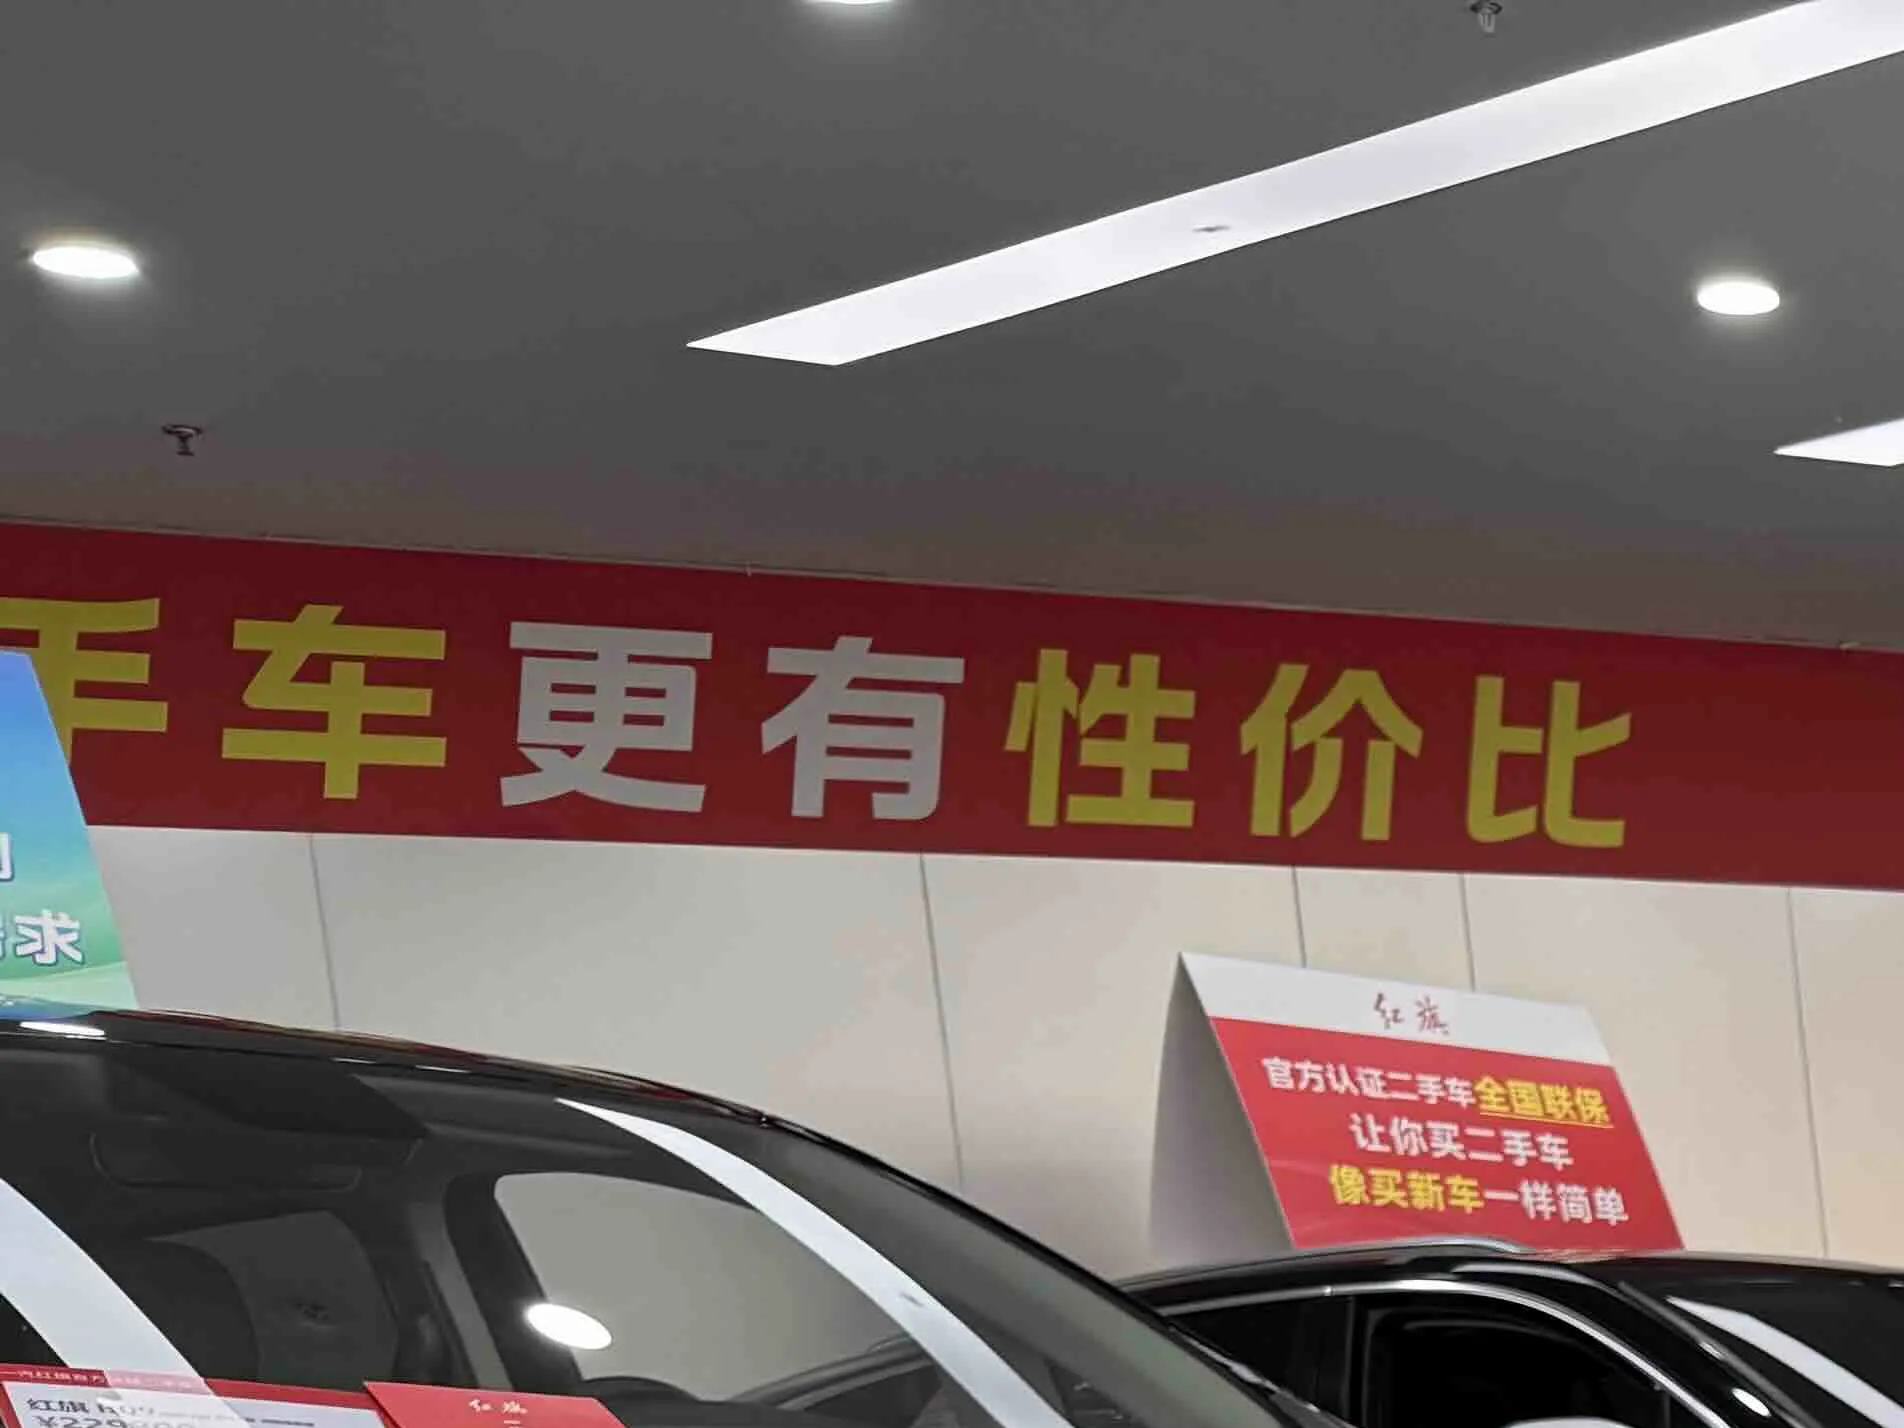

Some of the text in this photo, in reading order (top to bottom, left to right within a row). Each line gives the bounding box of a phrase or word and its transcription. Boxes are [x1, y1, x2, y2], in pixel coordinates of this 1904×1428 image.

[0, 909, 84, 964] 求
[1373, 993, 1449, 1036] 红旗
[1261, 1056, 1613, 1127] 官方认证二手车全国联保
[1350, 1113, 1574, 1171] 让你买二手车
[1329, 1164, 1629, 1227] 像买新车一样简单
